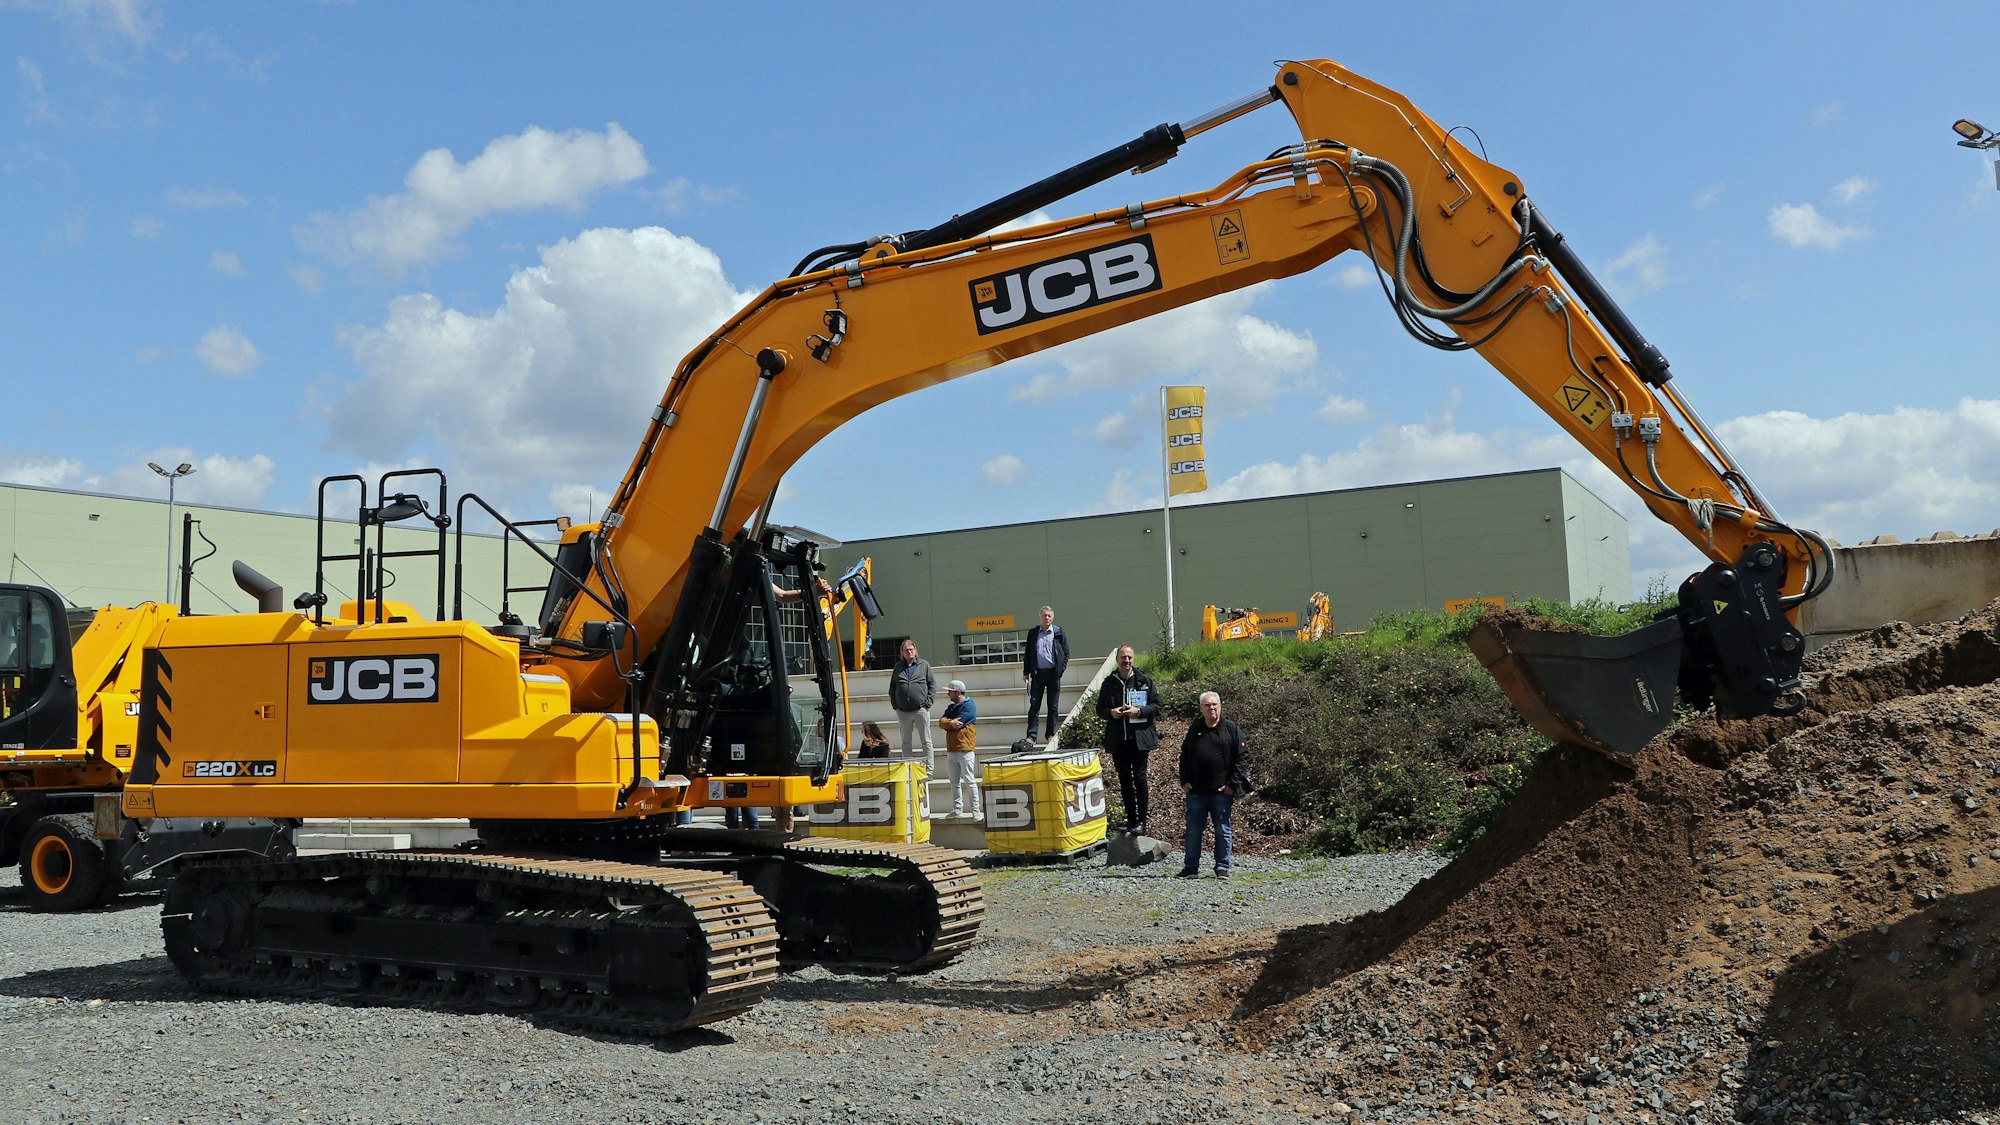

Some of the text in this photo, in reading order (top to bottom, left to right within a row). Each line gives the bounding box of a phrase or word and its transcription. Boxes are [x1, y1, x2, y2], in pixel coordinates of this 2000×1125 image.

[979, 242, 1156, 328] JCB
[1170, 406, 1203, 419] JCB
[1171, 460, 1204, 474] JCB
[312, 658, 436, 701] JCB
[253, 764, 275, 777] LC
